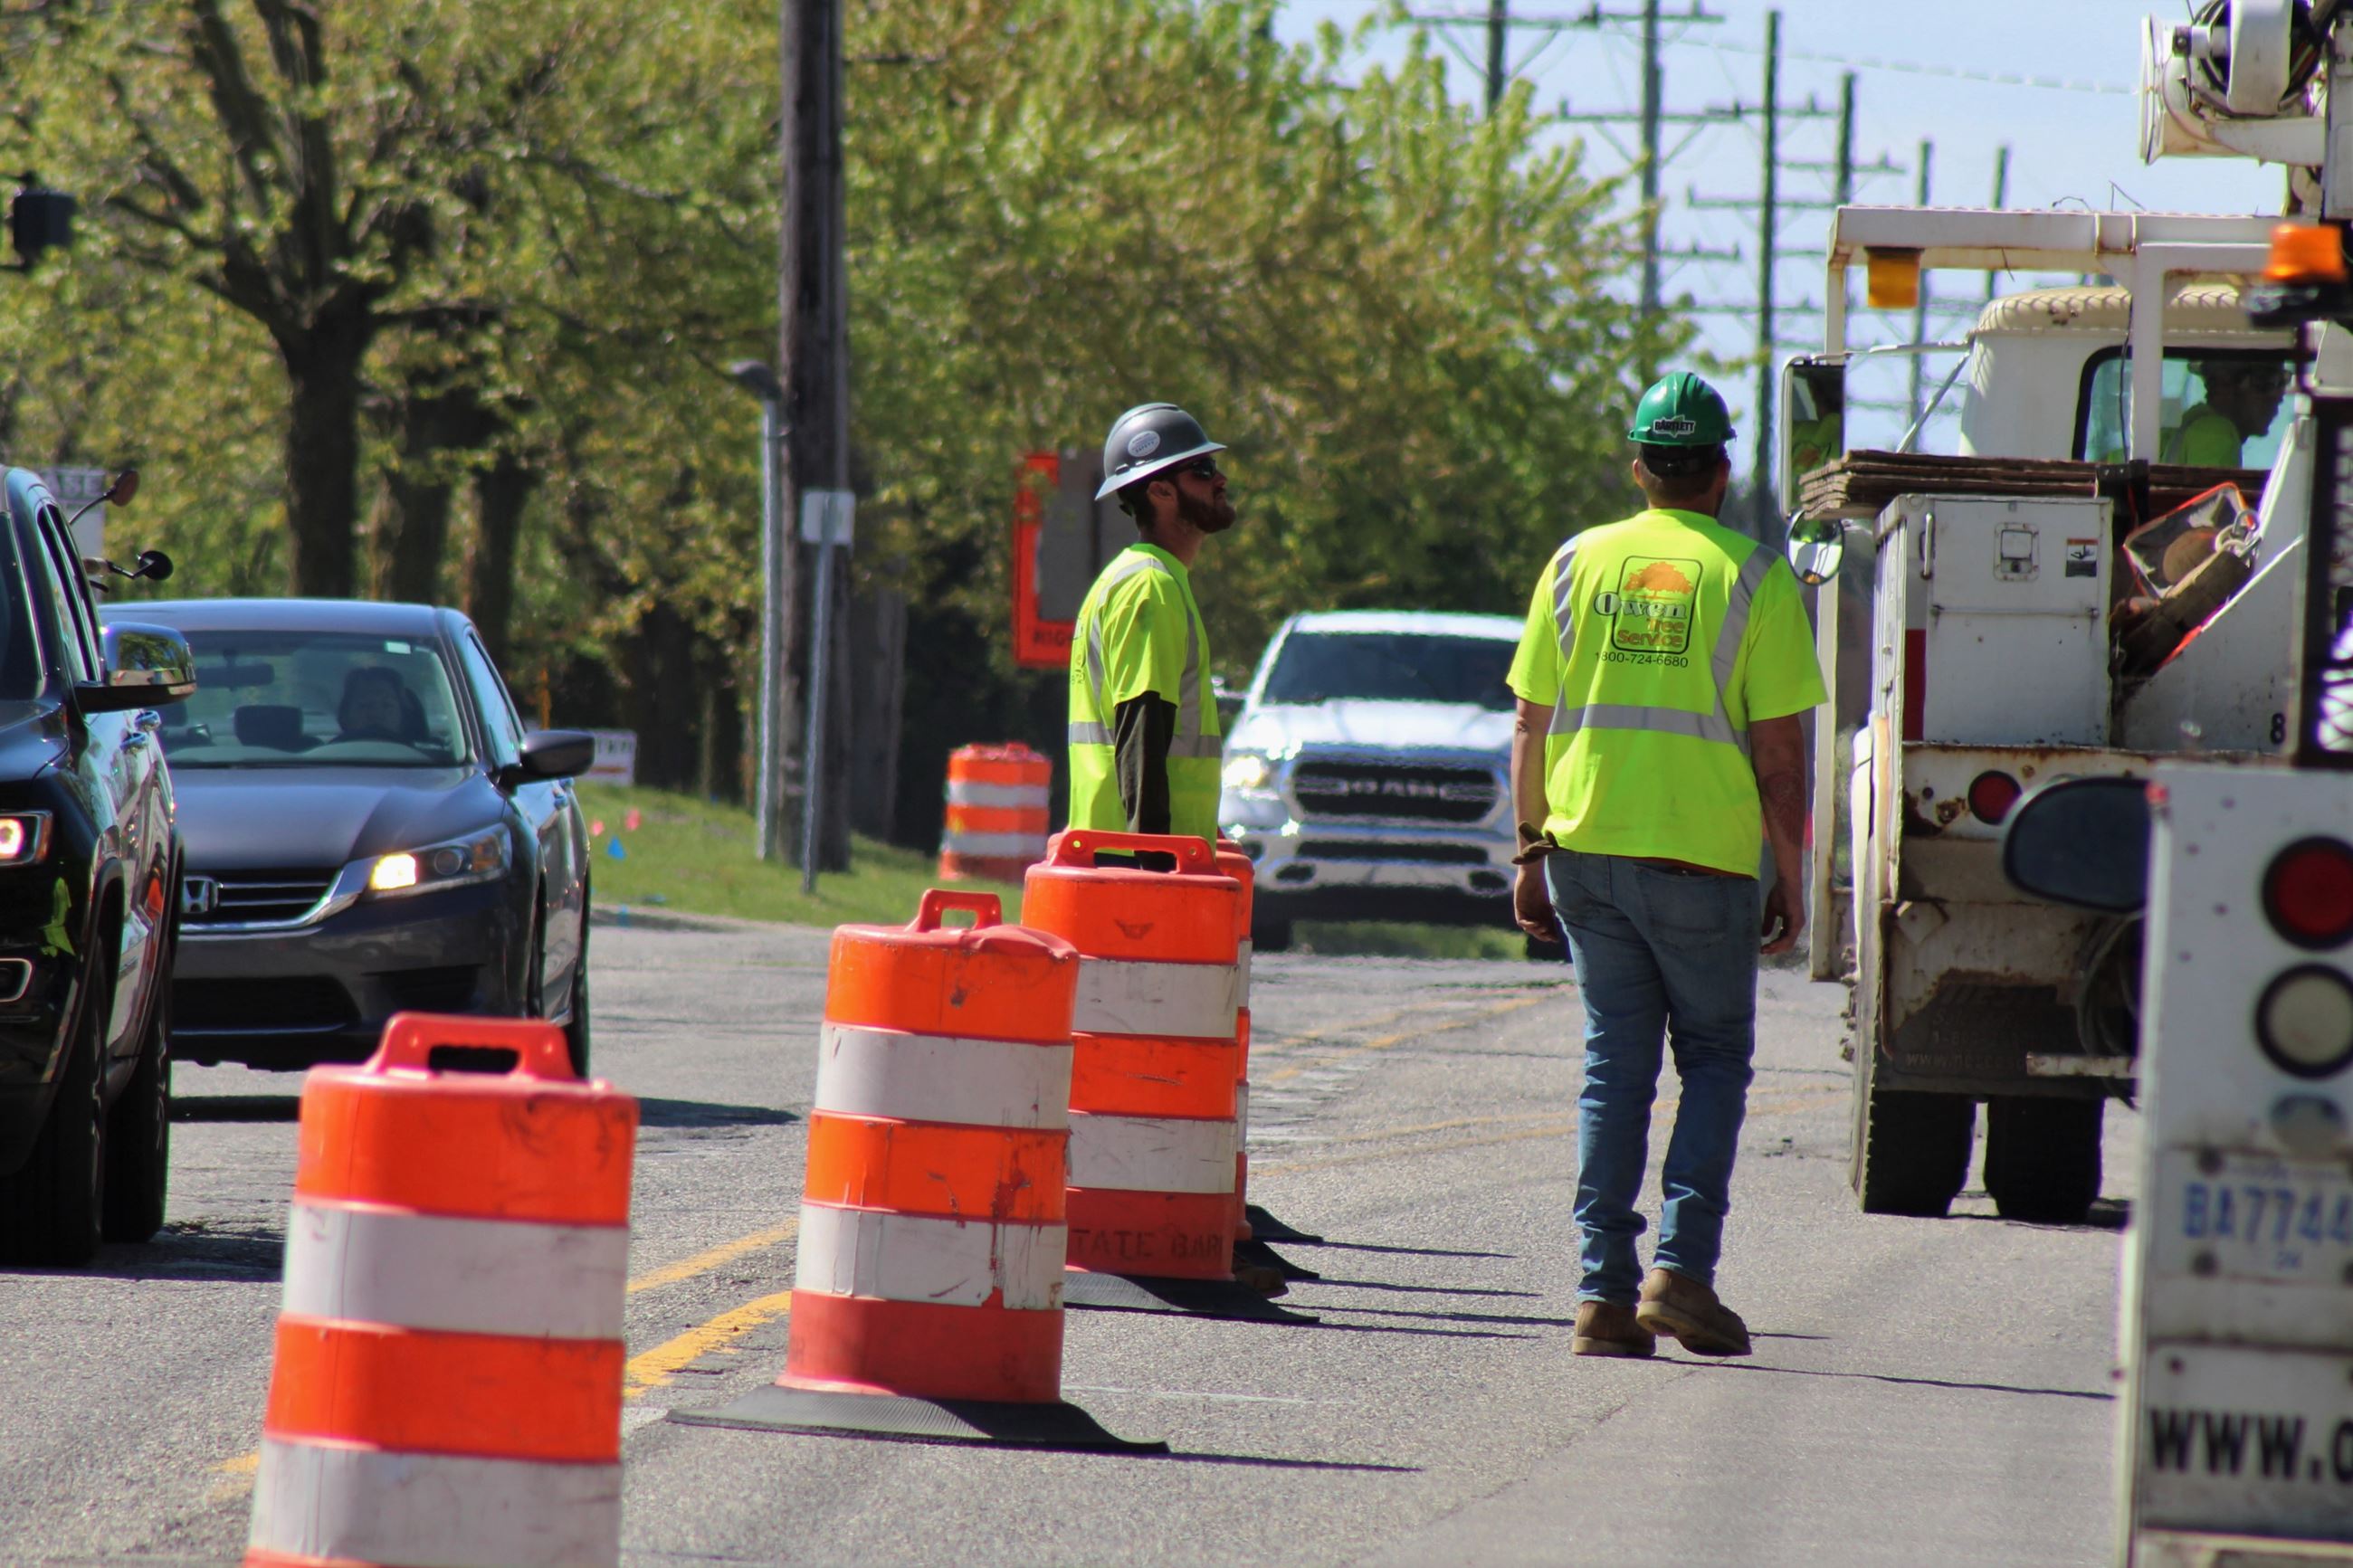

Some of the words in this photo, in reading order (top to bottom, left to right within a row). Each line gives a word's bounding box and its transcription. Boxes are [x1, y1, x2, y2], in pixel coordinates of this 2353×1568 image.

[1594, 592, 1688, 619] Owen
[1647, 618, 1685, 633] Tree
[1616, 629, 1684, 647] Service
